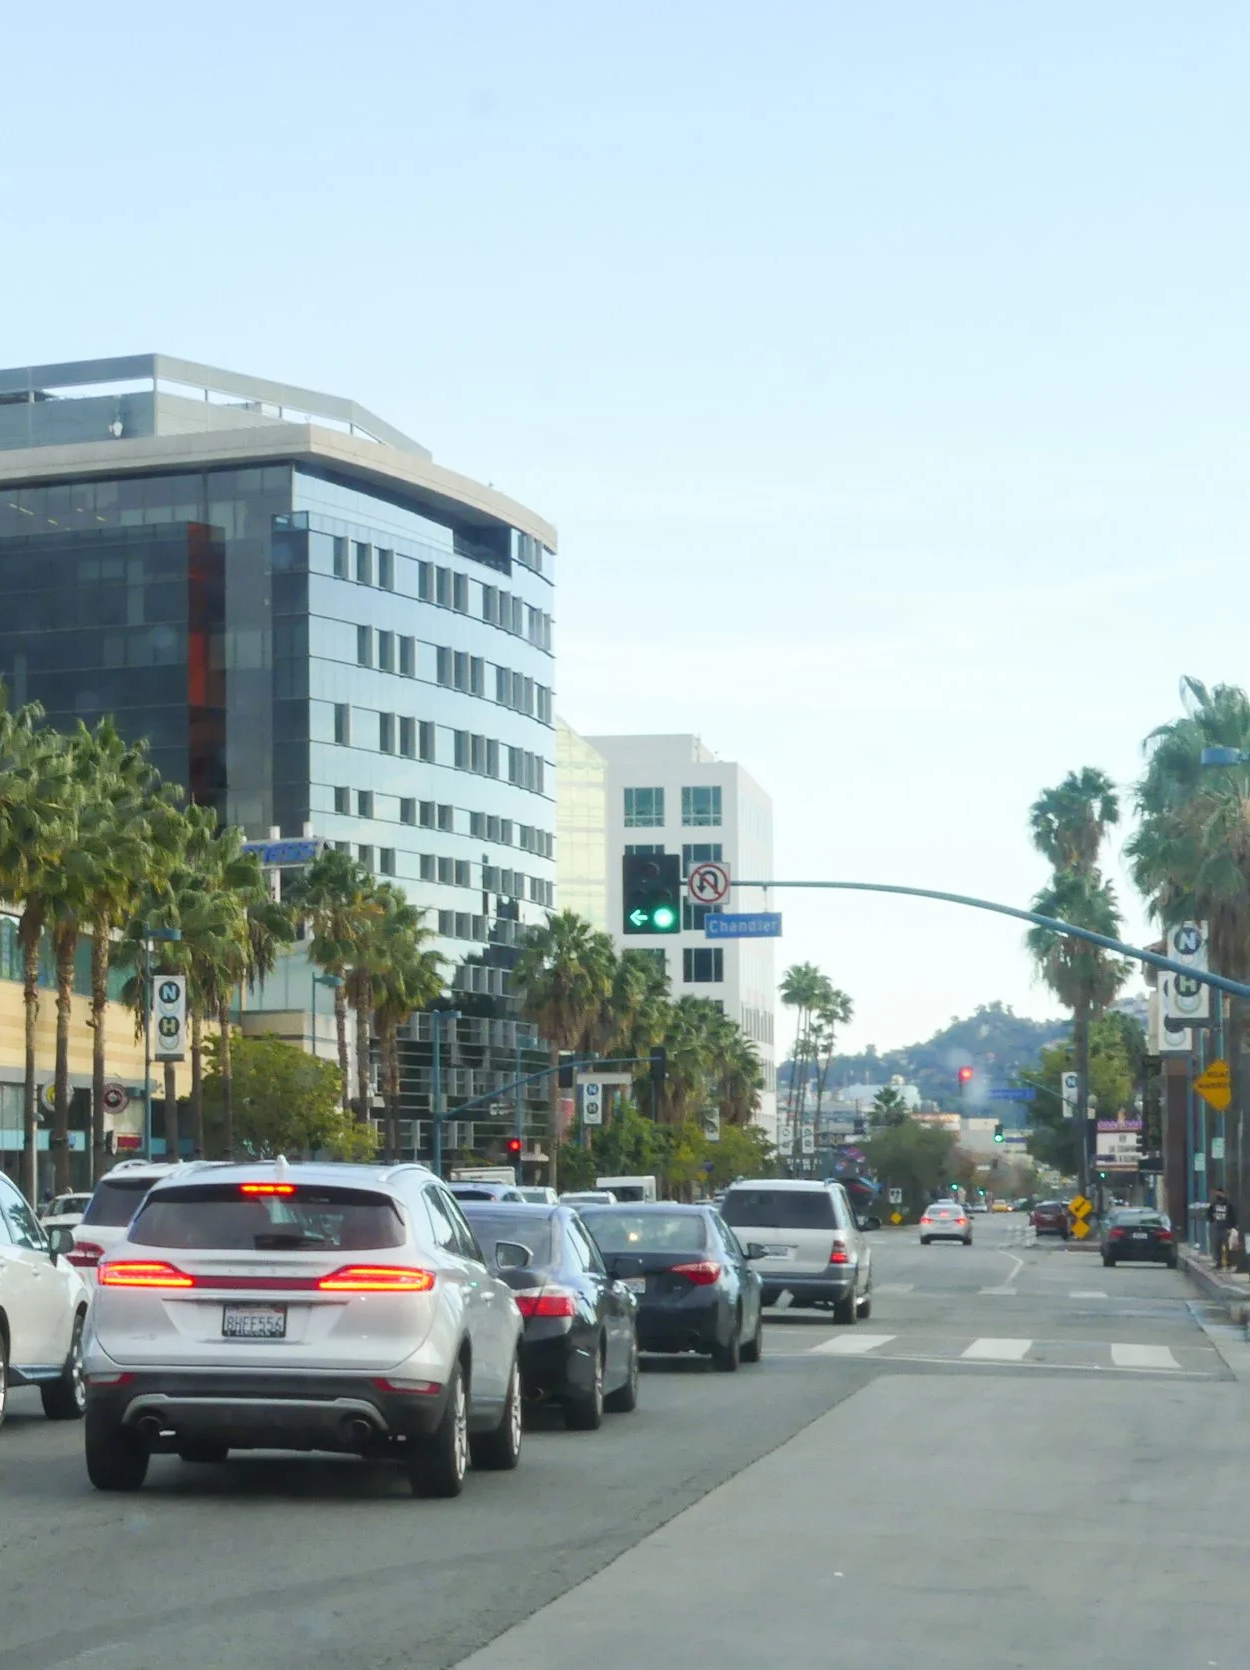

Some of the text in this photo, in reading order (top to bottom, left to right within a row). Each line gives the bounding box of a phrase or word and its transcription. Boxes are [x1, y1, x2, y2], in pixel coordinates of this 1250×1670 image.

[709, 918, 778, 933] Chandler
[162, 984, 178, 1000] N
[162, 1018, 177, 1034] H
